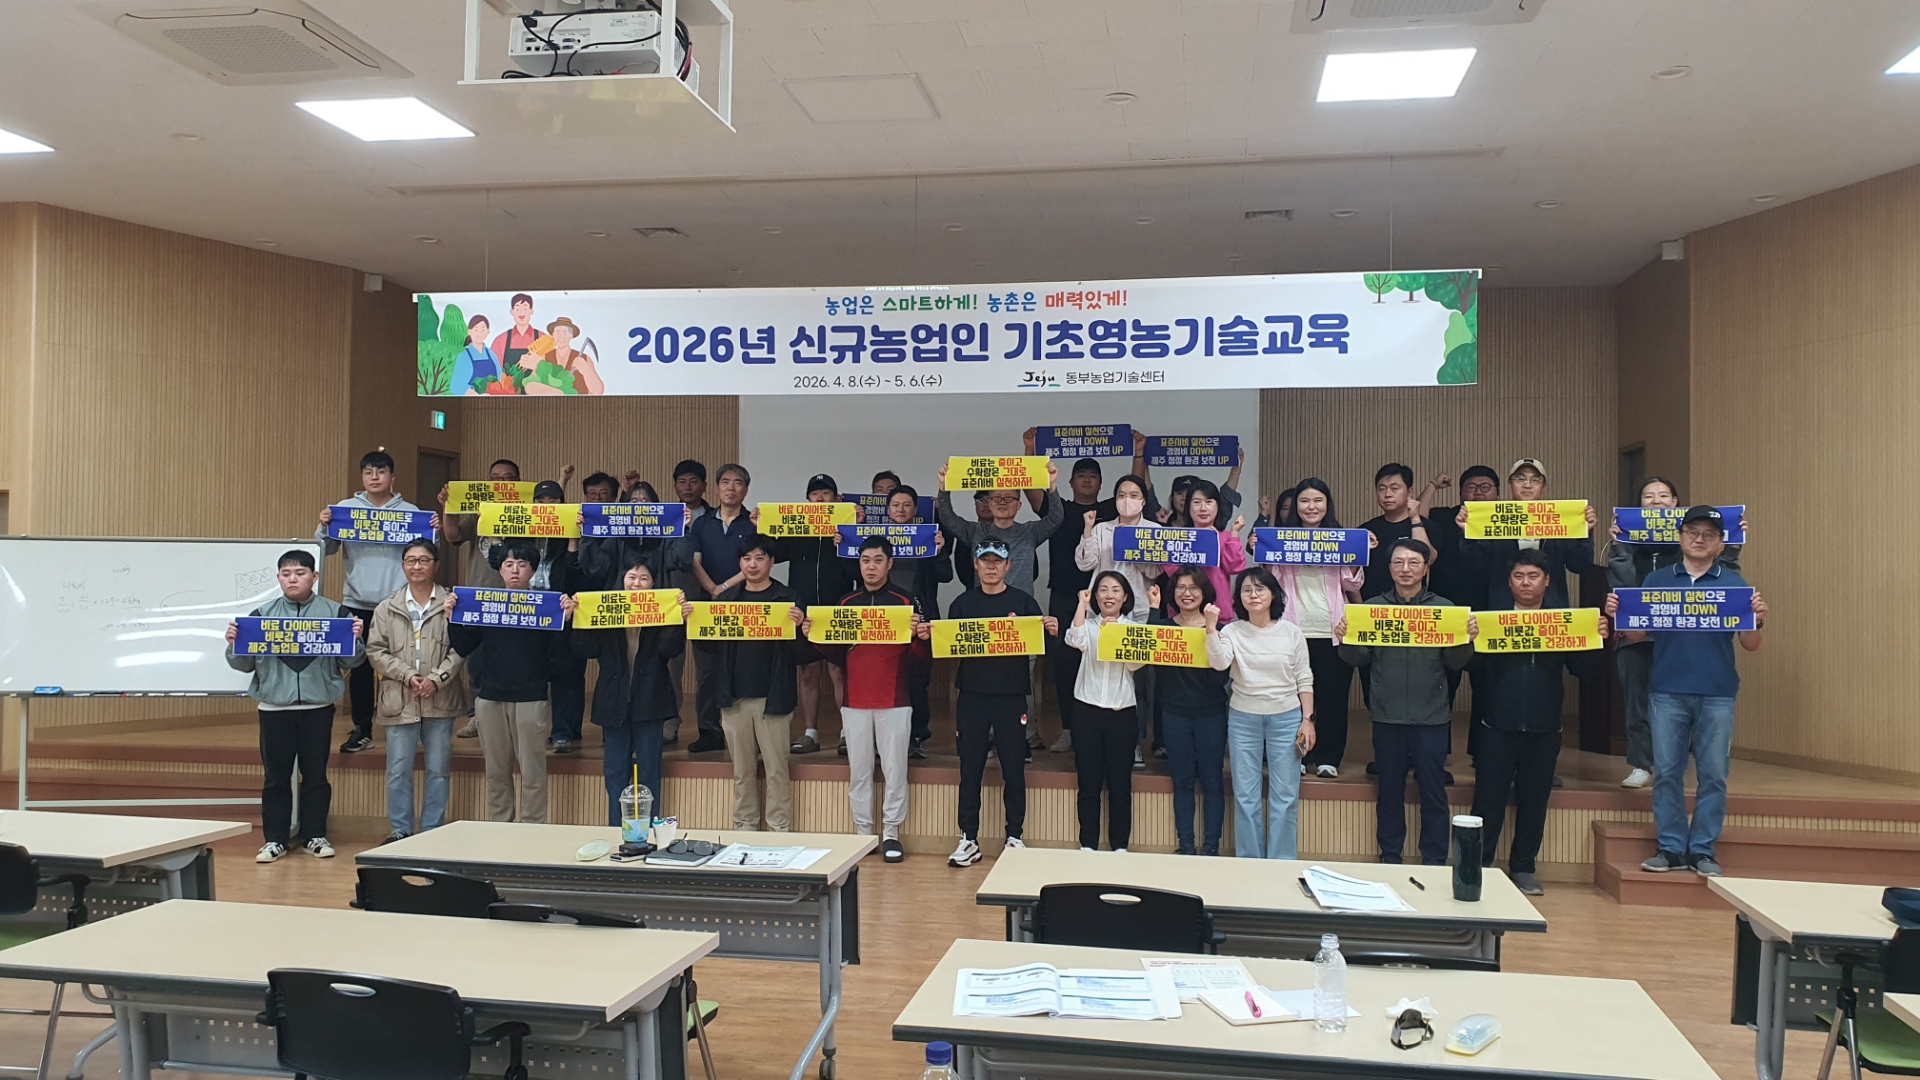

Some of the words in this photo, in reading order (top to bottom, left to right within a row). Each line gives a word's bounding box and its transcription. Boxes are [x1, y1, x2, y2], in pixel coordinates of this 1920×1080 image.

[825, 295, 875, 316] 농업은
[882, 294, 978, 312] 스마트하게!
[986, 291, 1037, 313] 농촌은
[1045, 290, 1128, 311] 매력있게!
[628, 325, 777, 364] 2026년
[789, 322, 990, 364] 신규농업인
[1003, 313, 1351, 361] 기초영농기술교육
[793, 376, 830, 388] 2026.
[833, 376, 845, 388] 4.
[848, 374, 881, 388] 8.(수)
[894, 375, 906, 387] 5.
[909, 374, 943, 388] 6.(수)
[1022, 369, 1056, 387] Jeju
[1066, 371, 1165, 385] 동부농업기술센터
[970, 458, 995, 468] 비료는
[998, 457, 1022, 467] 줄이고
[966, 466, 999, 478] 수확량은
[1002, 466, 1027, 477] 그대로
[961, 477, 994, 489] 표준시비
[996, 476, 1033, 488] 실천하자!
[503, 505, 528, 515] 비료는
[531, 505, 555, 515] 줄이고
[601, 505, 632, 515] 표준시비
[633, 505, 664, 515] 실천으로
[778, 505, 794, 514] 비료
[796, 505, 835, 515] 다이어트로
[1495, 503, 1523, 514] 비료는
[1527, 502, 1555, 514] 줄이고
[350, 509, 368, 520] 비료
[370, 510, 413, 523] 다이어트로
[498, 514, 532, 525] 수확량은
[534, 515, 559, 526] 그대로
[633, 515, 658, 525] DOWN
[781, 514, 806, 525] 비룟값
[808, 514, 831, 525] 줄이고
[1490, 513, 1529, 525] 수확량은
[1532, 513, 1560, 525] 그대로
[353, 519, 380, 531] 비룟값
[382, 520, 408, 533] 줄이고
[493, 524, 526, 535] 표준시비
[528, 524, 565, 536] 실천하자!
[592, 525, 609, 535] 제주
[662, 525, 675, 535] UP
[769, 524, 784, 535] 제주
[787, 524, 810, 535] 농업을
[813, 524, 835, 536] 건강하
[856, 526, 886, 536] 표준시비
[888, 526, 918, 536] 실천으로
[1484, 525, 1522, 537] 표준시비
[1525, 525, 1567, 537] 실천하자!
[338, 528, 356, 539] 제주
[358, 529, 385, 541] 농업을
[1135, 528, 1152, 539] 비료
[1154, 529, 1197, 541] 다이어트로
[1276, 529, 1310, 540] 표준시비
[1312, 530, 1346, 541] 실천으로
[915, 546, 928, 556] UP
[1138, 539, 1164, 551] 비룟값
[1166, 540, 1192, 552] 줄이고
[1310, 541, 1339, 552] DOWN
[1124, 549, 1141, 560] 제주
[1143, 550, 1169, 562] 농업을
[1171, 551, 1206, 564] 건강하게
[1265, 551, 1283, 562] 제주
[1343, 553, 1356, 563] UP
[474, 590, 508, 602] 표준시비
[510, 592, 543, 604] 실천으로
[601, 593, 627, 604] 비료는
[630, 592, 655, 603] 줄이고
[1641, 591, 1682, 603] 표준시비
[1684, 590, 1726, 603] 실천으로
[508, 603, 536, 615] DOWN
[597, 603, 631, 615] 수확량은
[634, 602, 660, 614] 그대로
[709, 604, 726, 615] 비료
[729, 604, 771, 615] 다이어트로
[833, 608, 858, 619] 비료는
[861, 608, 886, 619] 줄이고
[1370, 608, 1389, 619] 비료
[1392, 608, 1442, 620] 다이어트로
[1683, 603, 1717, 615] DOWN
[462, 611, 480, 623] 제주
[539, 616, 552, 627] UP
[590, 614, 625, 626] 표준시비
[628, 612, 665, 625] 실천하자!
[713, 615, 740, 627] 비룟값
[742, 615, 767, 627] 줄이고
[829, 618, 863, 630] 수확량은
[865, 619, 891, 630] 그대로
[1498, 613, 1518, 626] 비료
[1522, 611, 1573, 625] 다이어트로
[1628, 615, 1649, 627] 제주
[1723, 616, 1740, 628] UP
[260, 619, 280, 631] 비료
[283, 619, 330, 632] 다이어트로
[958, 621, 985, 633] 비료는
[988, 619, 1014, 632] 줄이고
[1374, 619, 1405, 632] 비룟값
[1407, 620, 1437, 632] 줄이고
[1503, 625, 1535, 637] 비룟값
[1538, 624, 1568, 637] 줄이고
[264, 630, 294, 643] 비룟값
[297, 630, 325, 643] 줄이고
[699, 626, 716, 637] 제주
[719, 626, 744, 637] 농업을
[748, 626, 782, 638] 건강하게
[824, 629, 858, 641] 표준시비
[860, 629, 897, 641] 실천하자!
[955, 631, 990, 644] 수확량은
[993, 630, 1020, 642] 그대로
[1126, 626, 1153, 639] 비료는
[1156, 628, 1183, 640] 줄이고
[1357, 630, 1377, 643] 제주
[1381, 631, 1410, 644] 농업을
[1414, 631, 1454, 644] 건강하게
[247, 642, 268, 653] 제주
[271, 642, 300, 654] 농업을
[303, 642, 341, 654] 건강하게
[949, 643, 985, 655] 표준시비
[987, 641, 1026, 654] 실천하자!
[1121, 637, 1157, 651] 수확량은
[1160, 639, 1187, 652] 그대로
[1487, 638, 1508, 650] 제주
[1511, 636, 1541, 650] 농업을
[1545, 635, 1587, 649] 건강하게
[1115, 648, 1150, 662] 표준시비
[1153, 650, 1193, 665] 실천하자!
